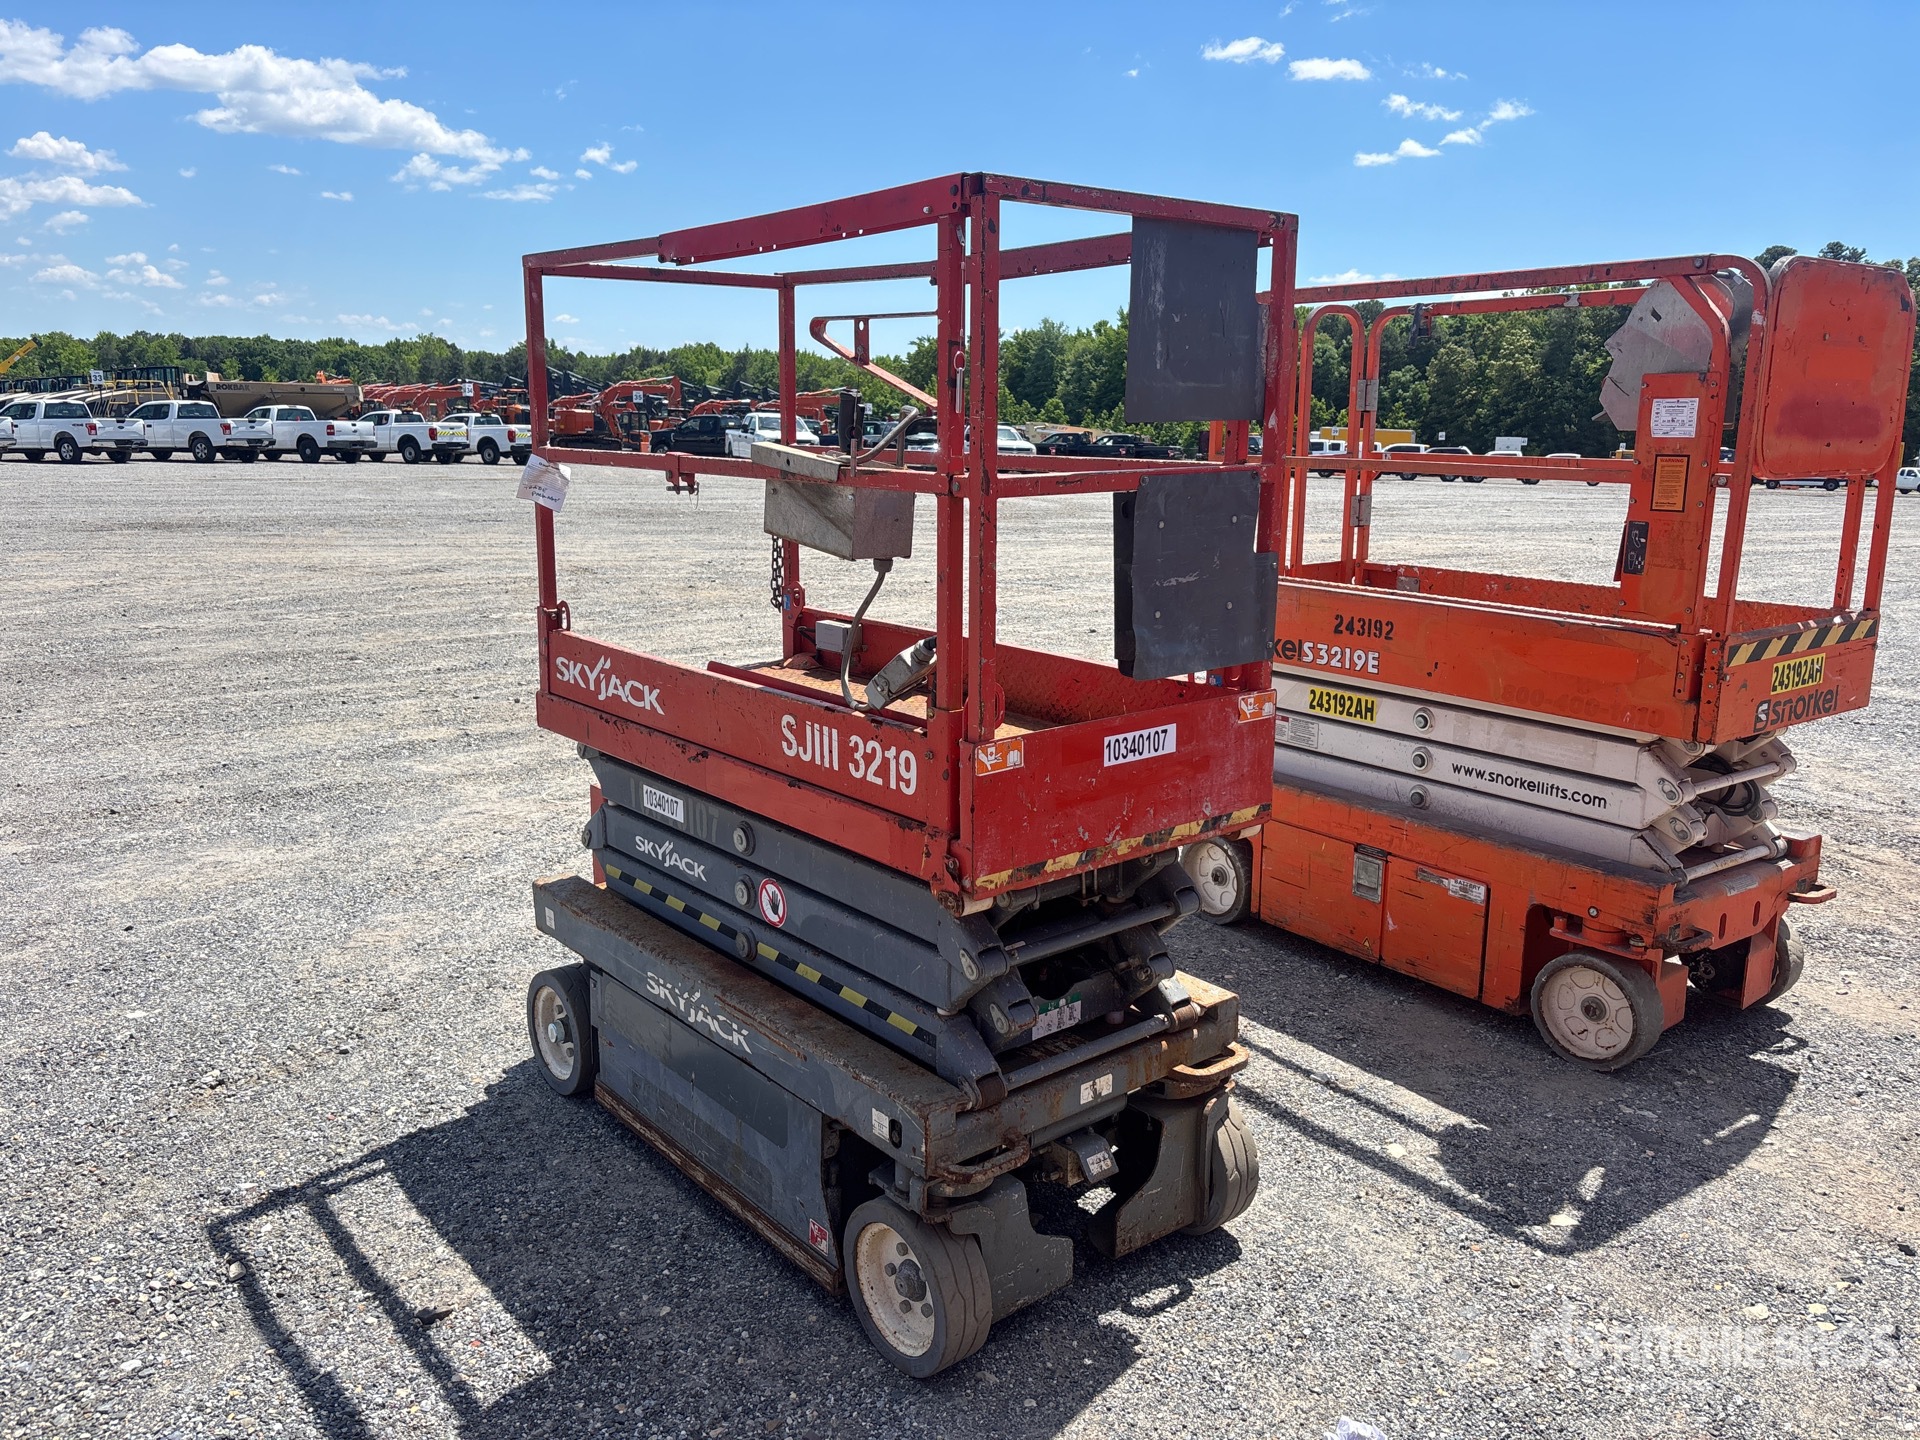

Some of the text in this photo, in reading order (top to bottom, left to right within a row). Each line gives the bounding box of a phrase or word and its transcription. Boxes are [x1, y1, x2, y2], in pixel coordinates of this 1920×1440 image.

[92, 374, 103, 382] 33
[1333, 614, 1395, 640] 243192
[1771, 656, 1824, 693] 243192AH
[1309, 689, 1375, 721] 243192AH
[1105, 728, 1168, 763] 10340107
[848, 734, 917, 796] 3219
[1451, 762, 1608, 810] www.snorkellifts.com
[645, 788, 679, 818] 10340107
[1454, 879, 1481, 891] BATTERY
